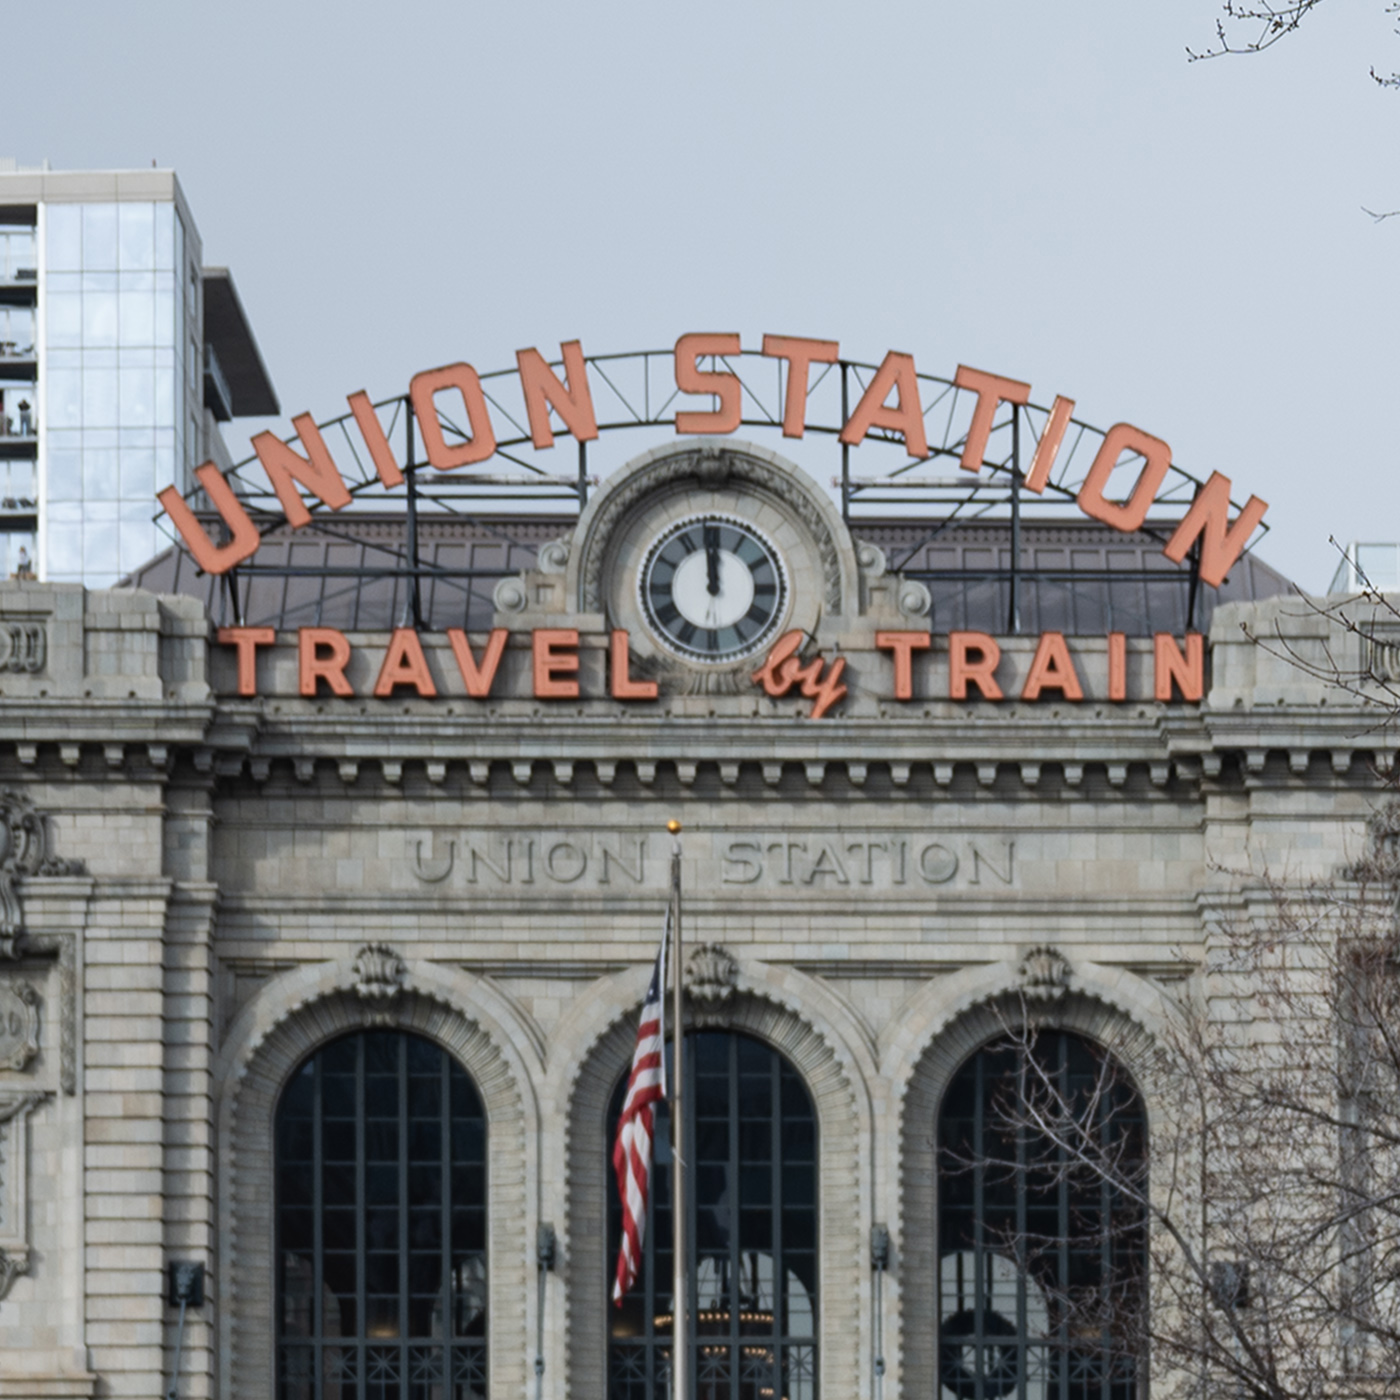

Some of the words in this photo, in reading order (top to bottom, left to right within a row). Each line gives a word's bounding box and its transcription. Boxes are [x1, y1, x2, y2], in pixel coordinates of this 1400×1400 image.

[156, 338, 600, 576] UNION
[673, 332, 1270, 589] STATION
[217, 625, 660, 699] TRAVEL
[751, 627, 849, 721] by
[872, 628, 1206, 702] TRAIN
[409, 838, 647, 884] UNION
[722, 840, 1017, 885] STATION
